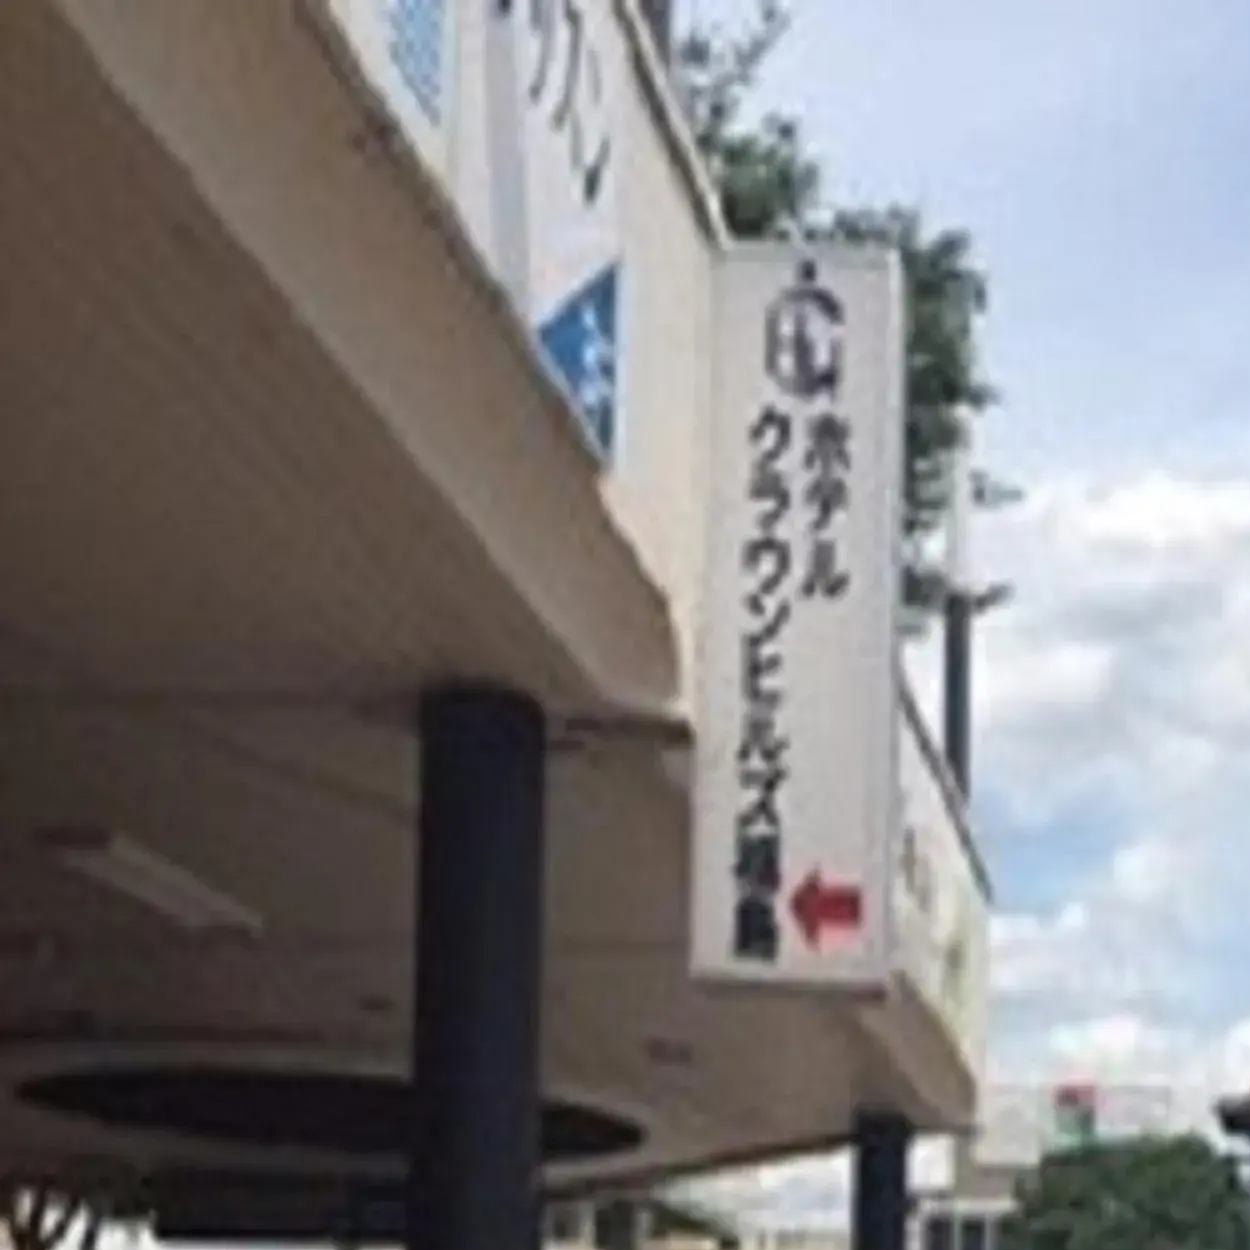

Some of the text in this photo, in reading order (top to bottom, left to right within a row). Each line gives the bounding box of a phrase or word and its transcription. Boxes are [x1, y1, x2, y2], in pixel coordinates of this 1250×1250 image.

[732, 404, 793, 962] クラウンヒルズ
[803, 412, 852, 600] ホテル
